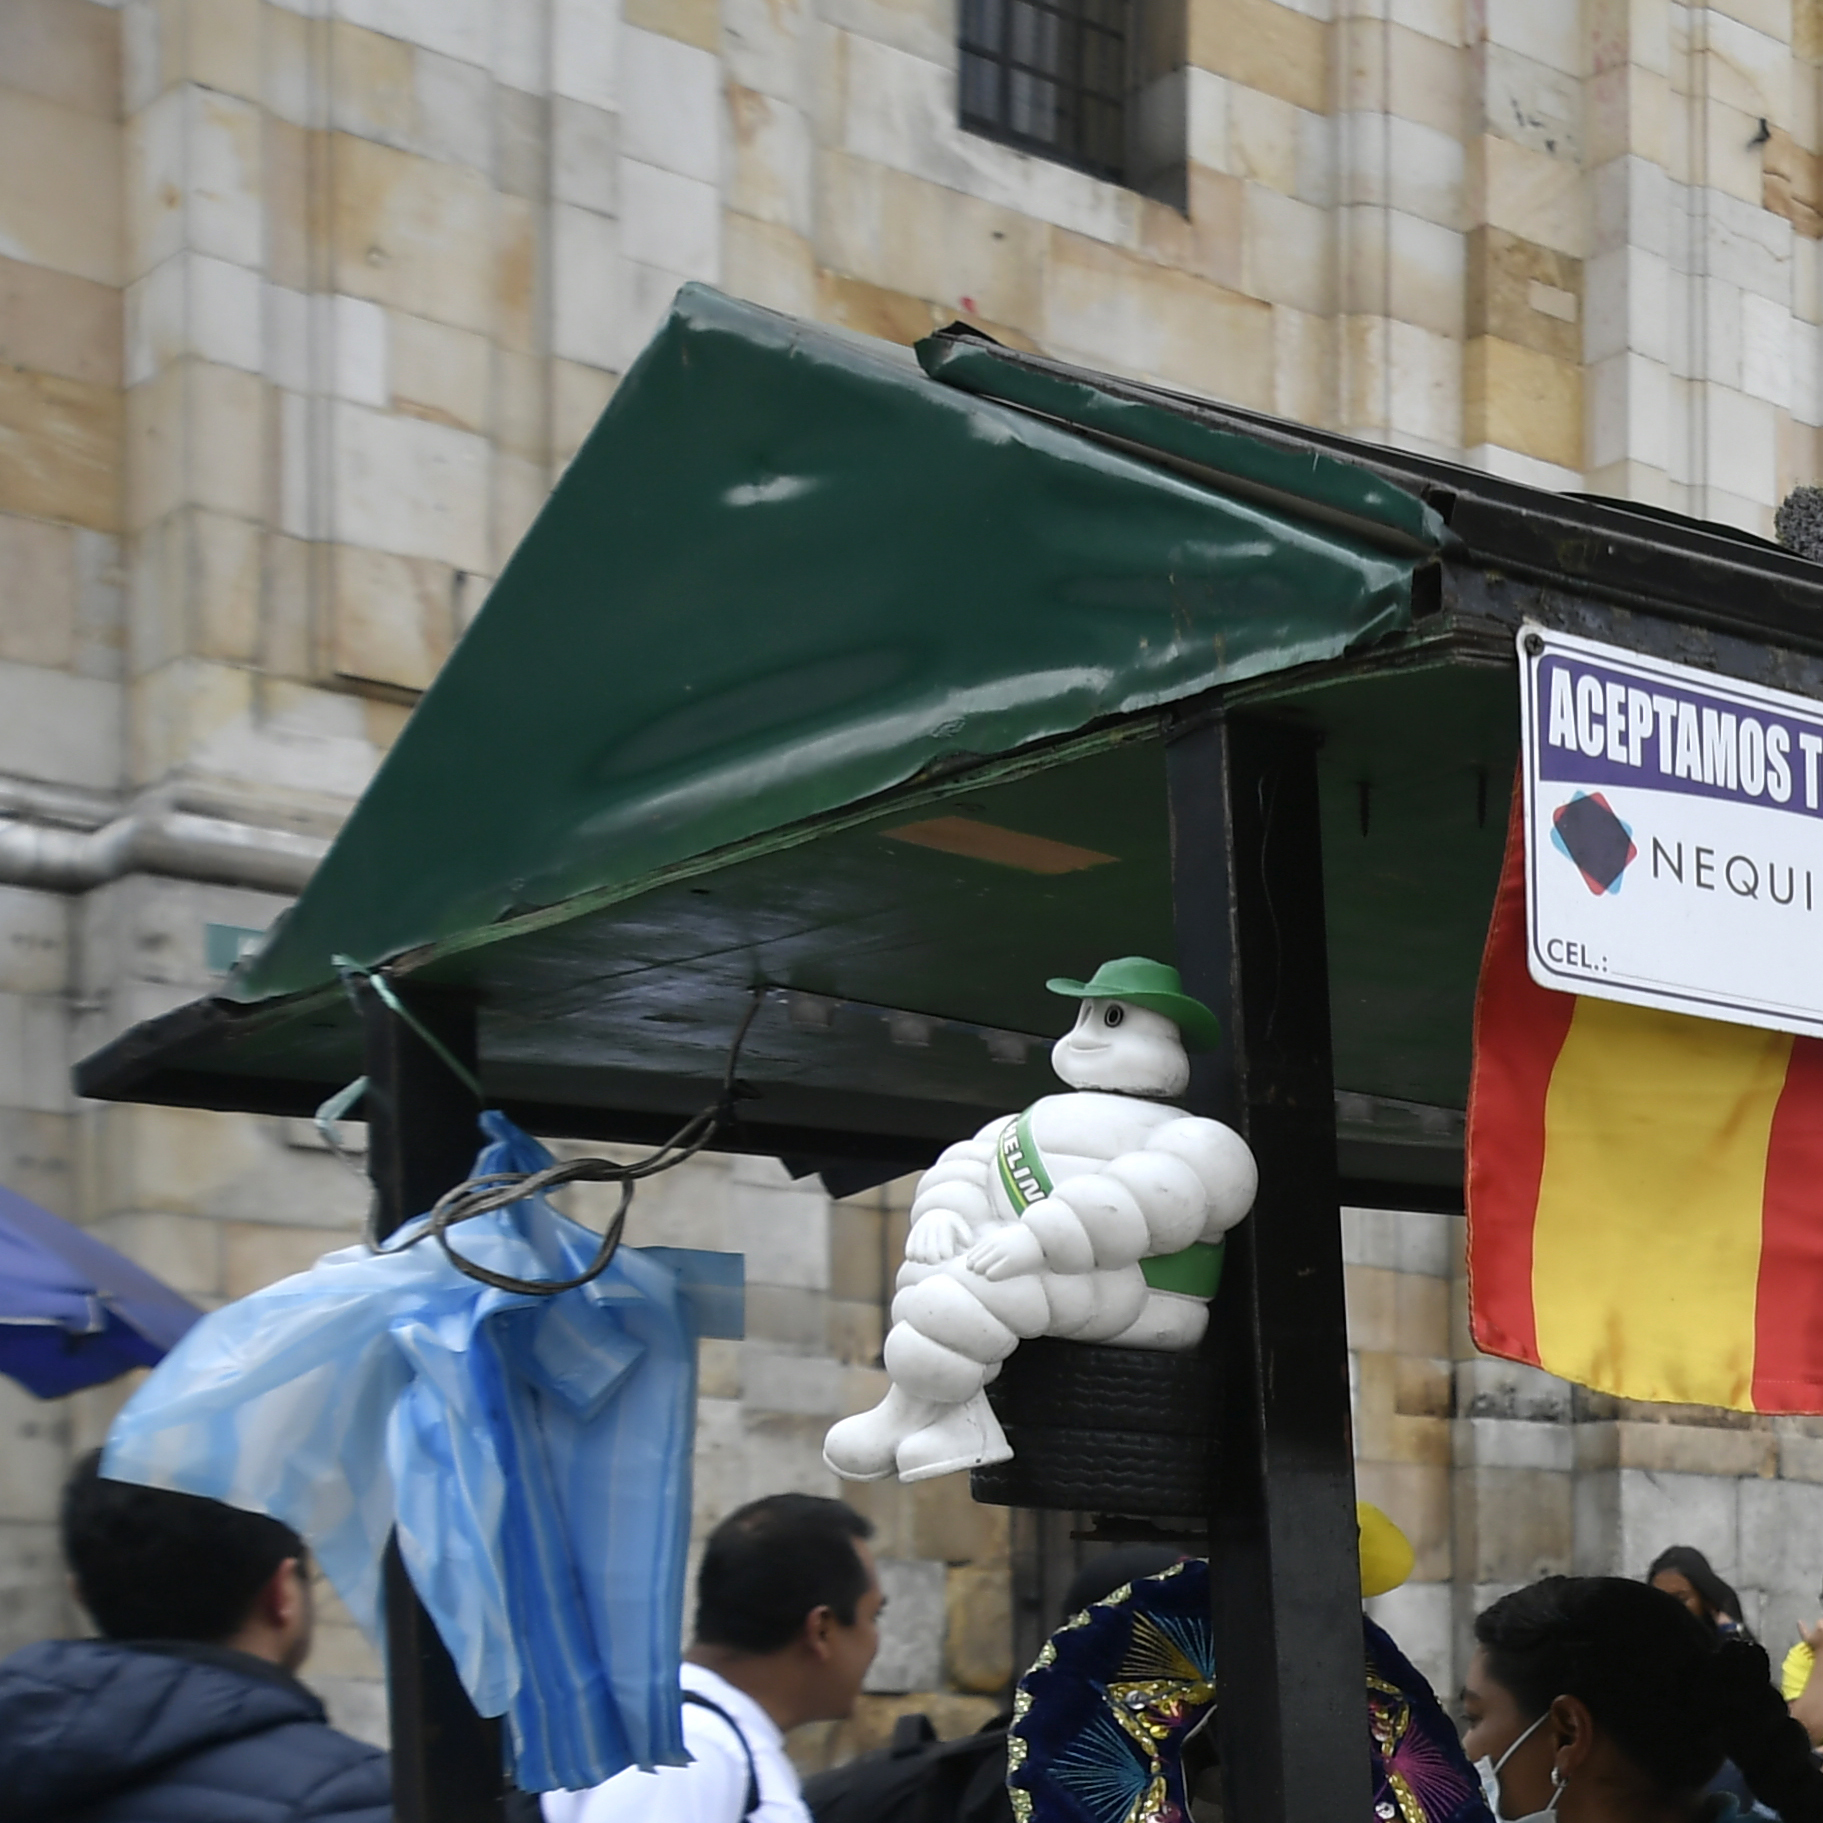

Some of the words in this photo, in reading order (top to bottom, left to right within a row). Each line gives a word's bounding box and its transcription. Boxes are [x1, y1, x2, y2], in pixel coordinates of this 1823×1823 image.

[1547, 666, 1793, 805] ACEPTAMOS
[1651, 836, 1815, 911] NEQUI
[1546, 937, 1610, 974] CEL.:
